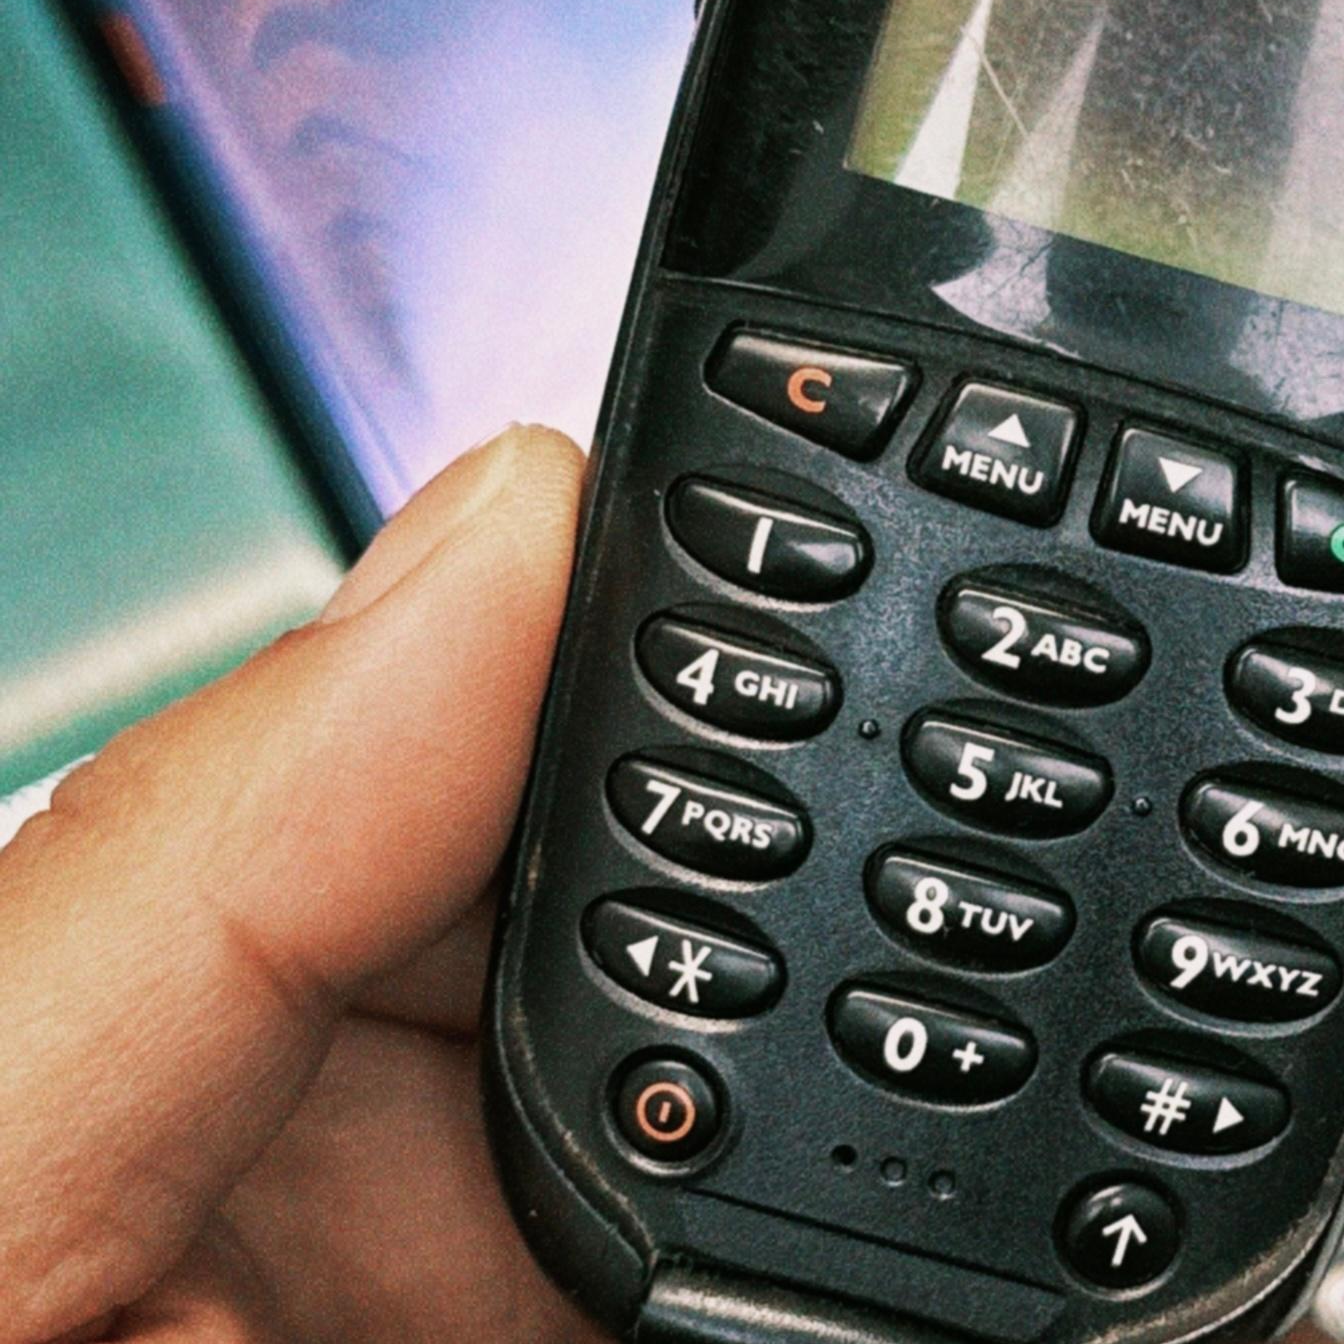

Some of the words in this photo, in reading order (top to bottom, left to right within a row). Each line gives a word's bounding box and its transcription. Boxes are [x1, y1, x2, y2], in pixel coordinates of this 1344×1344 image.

[787, 367, 832, 414] C
[941, 445, 1045, 495] MENU
[1118, 499, 1223, 547] MENU
[981, 606, 1026, 669] 2
[1030, 635, 1110, 674] ABC
[676, 649, 719, 706] 4
[734, 670, 799, 710] GHI
[1274, 667, 1316, 725] 3
[949, 742, 995, 802] 5
[1005, 772, 1063, 809] JKL
[641, 780, 681, 835] 7
[681, 800, 774, 850] PQRS
[1222, 800, 1263, 857] 6
[906, 877, 949, 934] 8
[957, 901, 1034, 942] TUV
[1170, 935, 1208, 989] 9
[1213, 952, 1323, 997] WXYZ
[884, 1018, 928, 1072] 0
